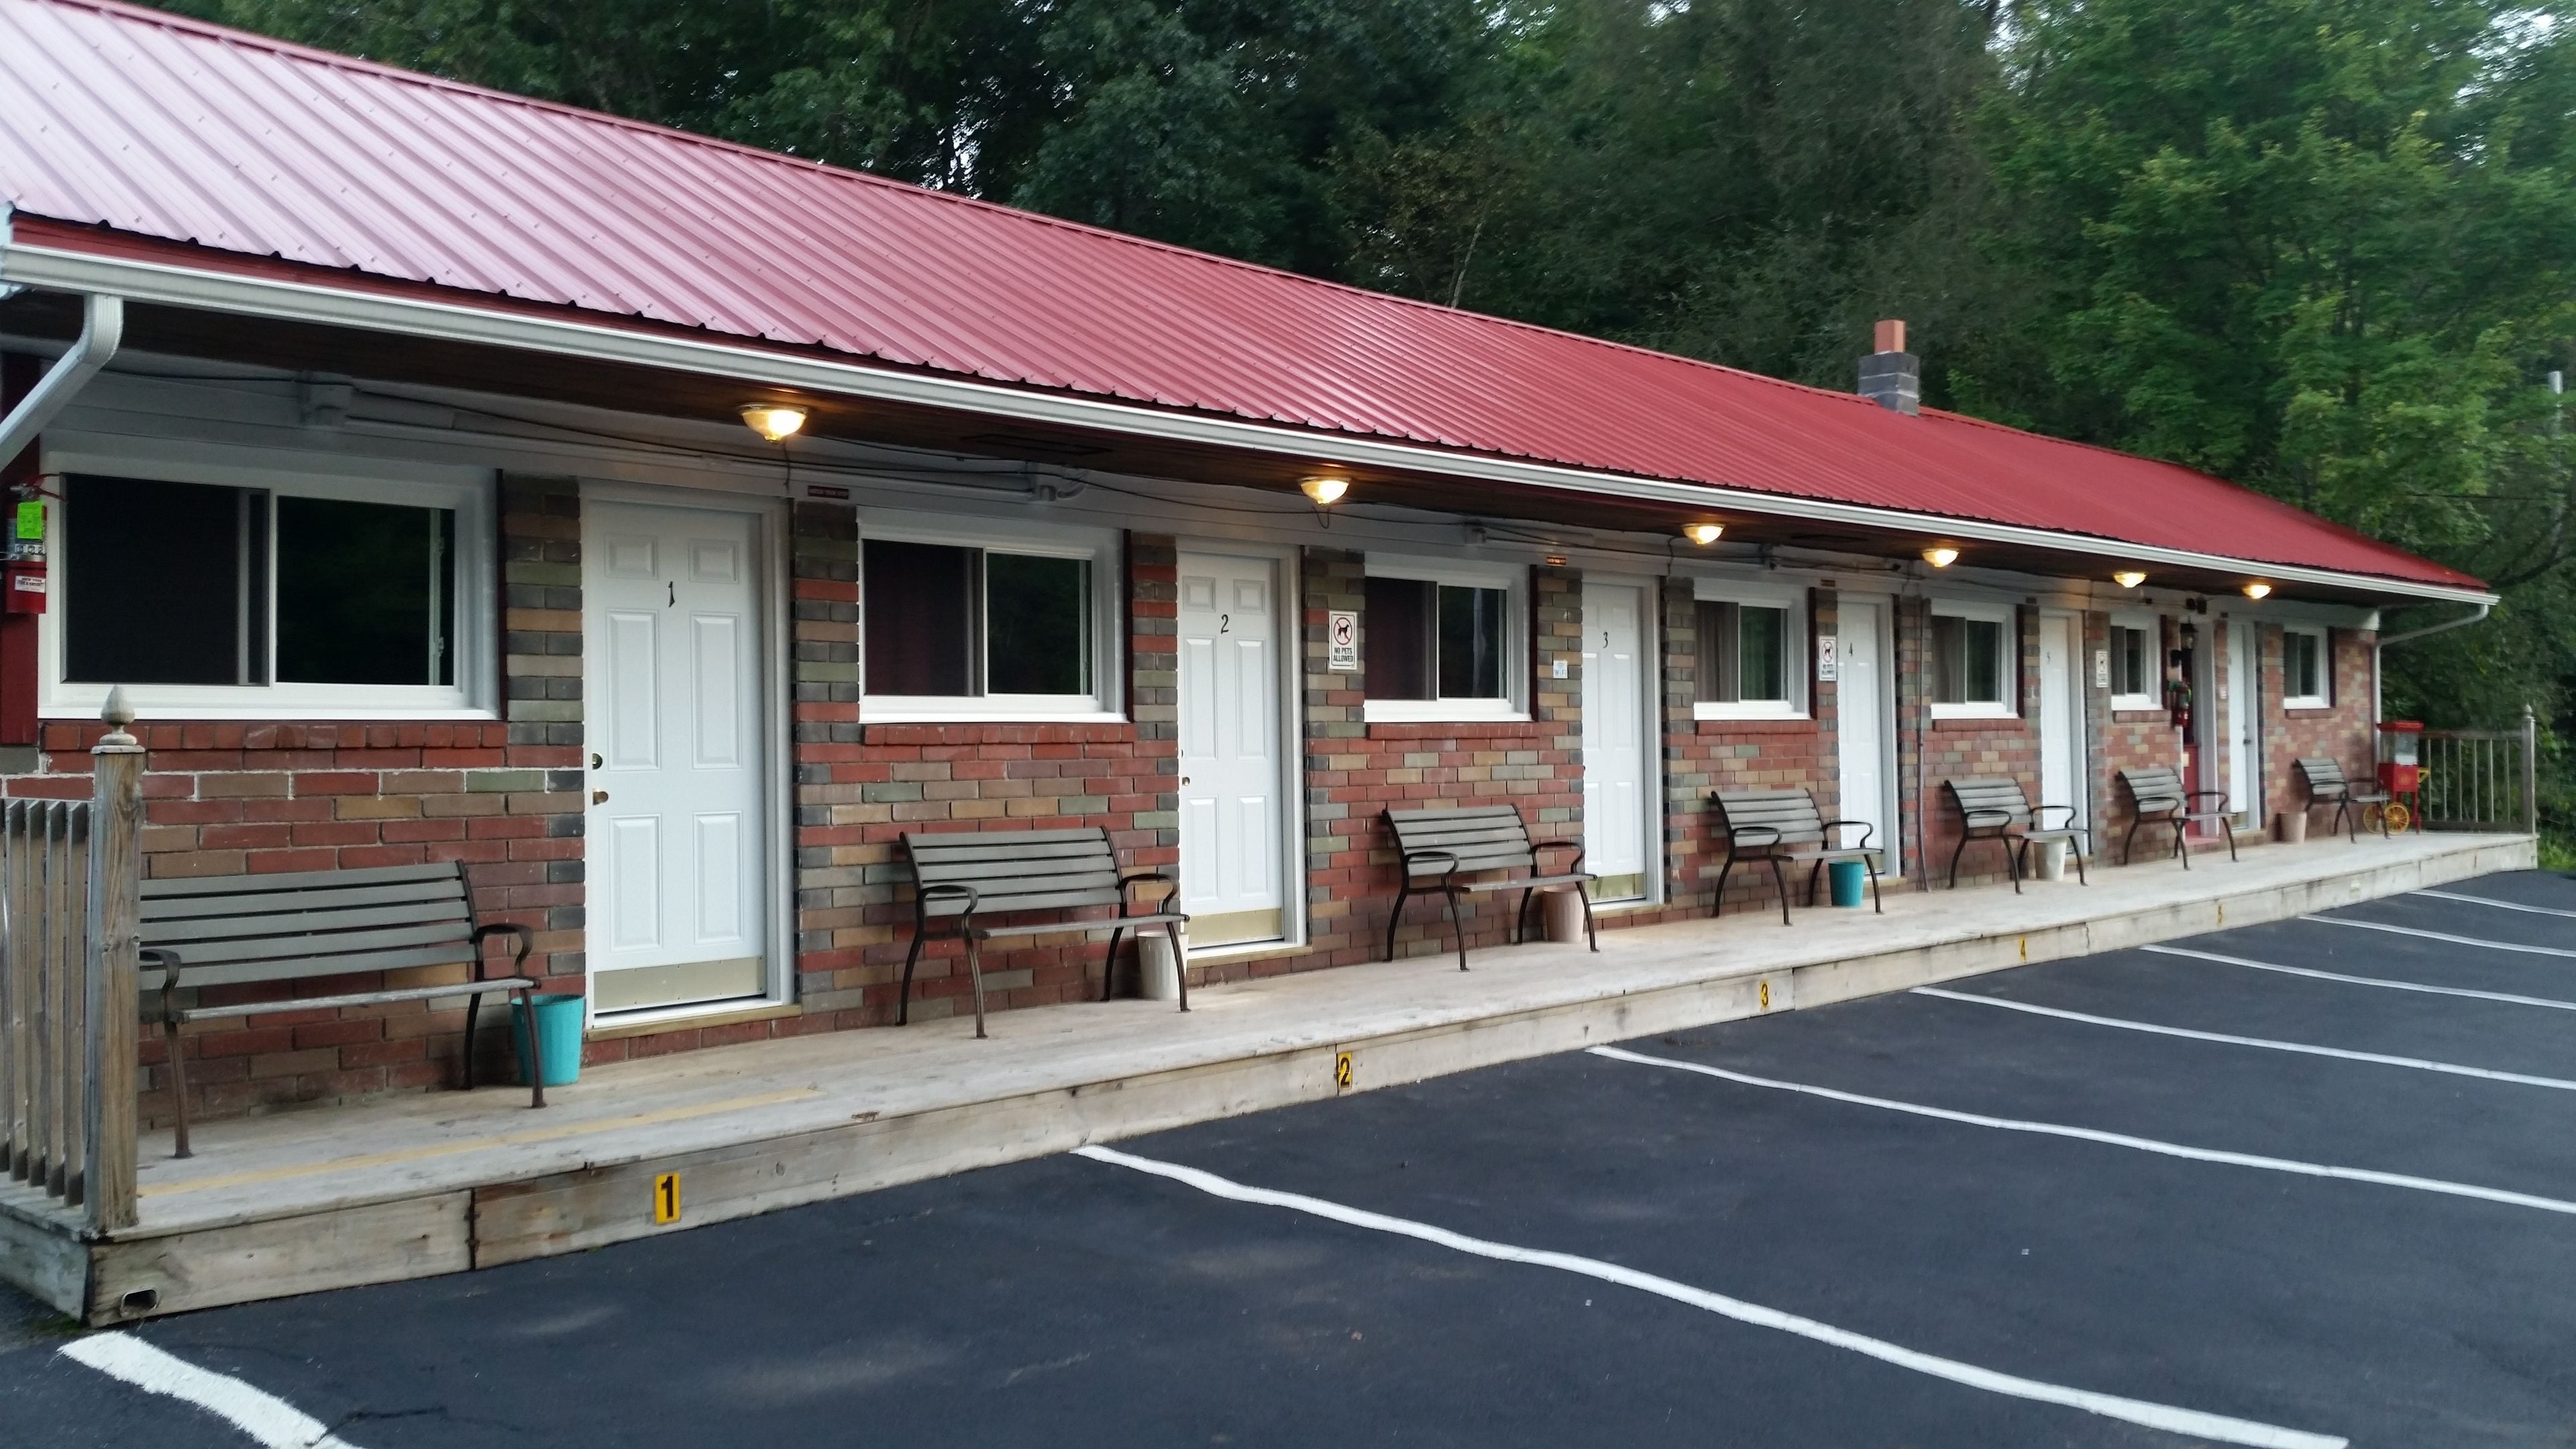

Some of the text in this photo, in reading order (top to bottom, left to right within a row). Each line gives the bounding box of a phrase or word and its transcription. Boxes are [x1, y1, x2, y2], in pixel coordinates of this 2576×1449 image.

[668, 581, 675, 608] 1
[1221, 614, 1229, 635] 2
[1603, 631, 1609, 649] 3
[1762, 983, 1768, 1007] 3
[1340, 1057, 1350, 1087] 2
[661, 1175, 674, 1218] 1
